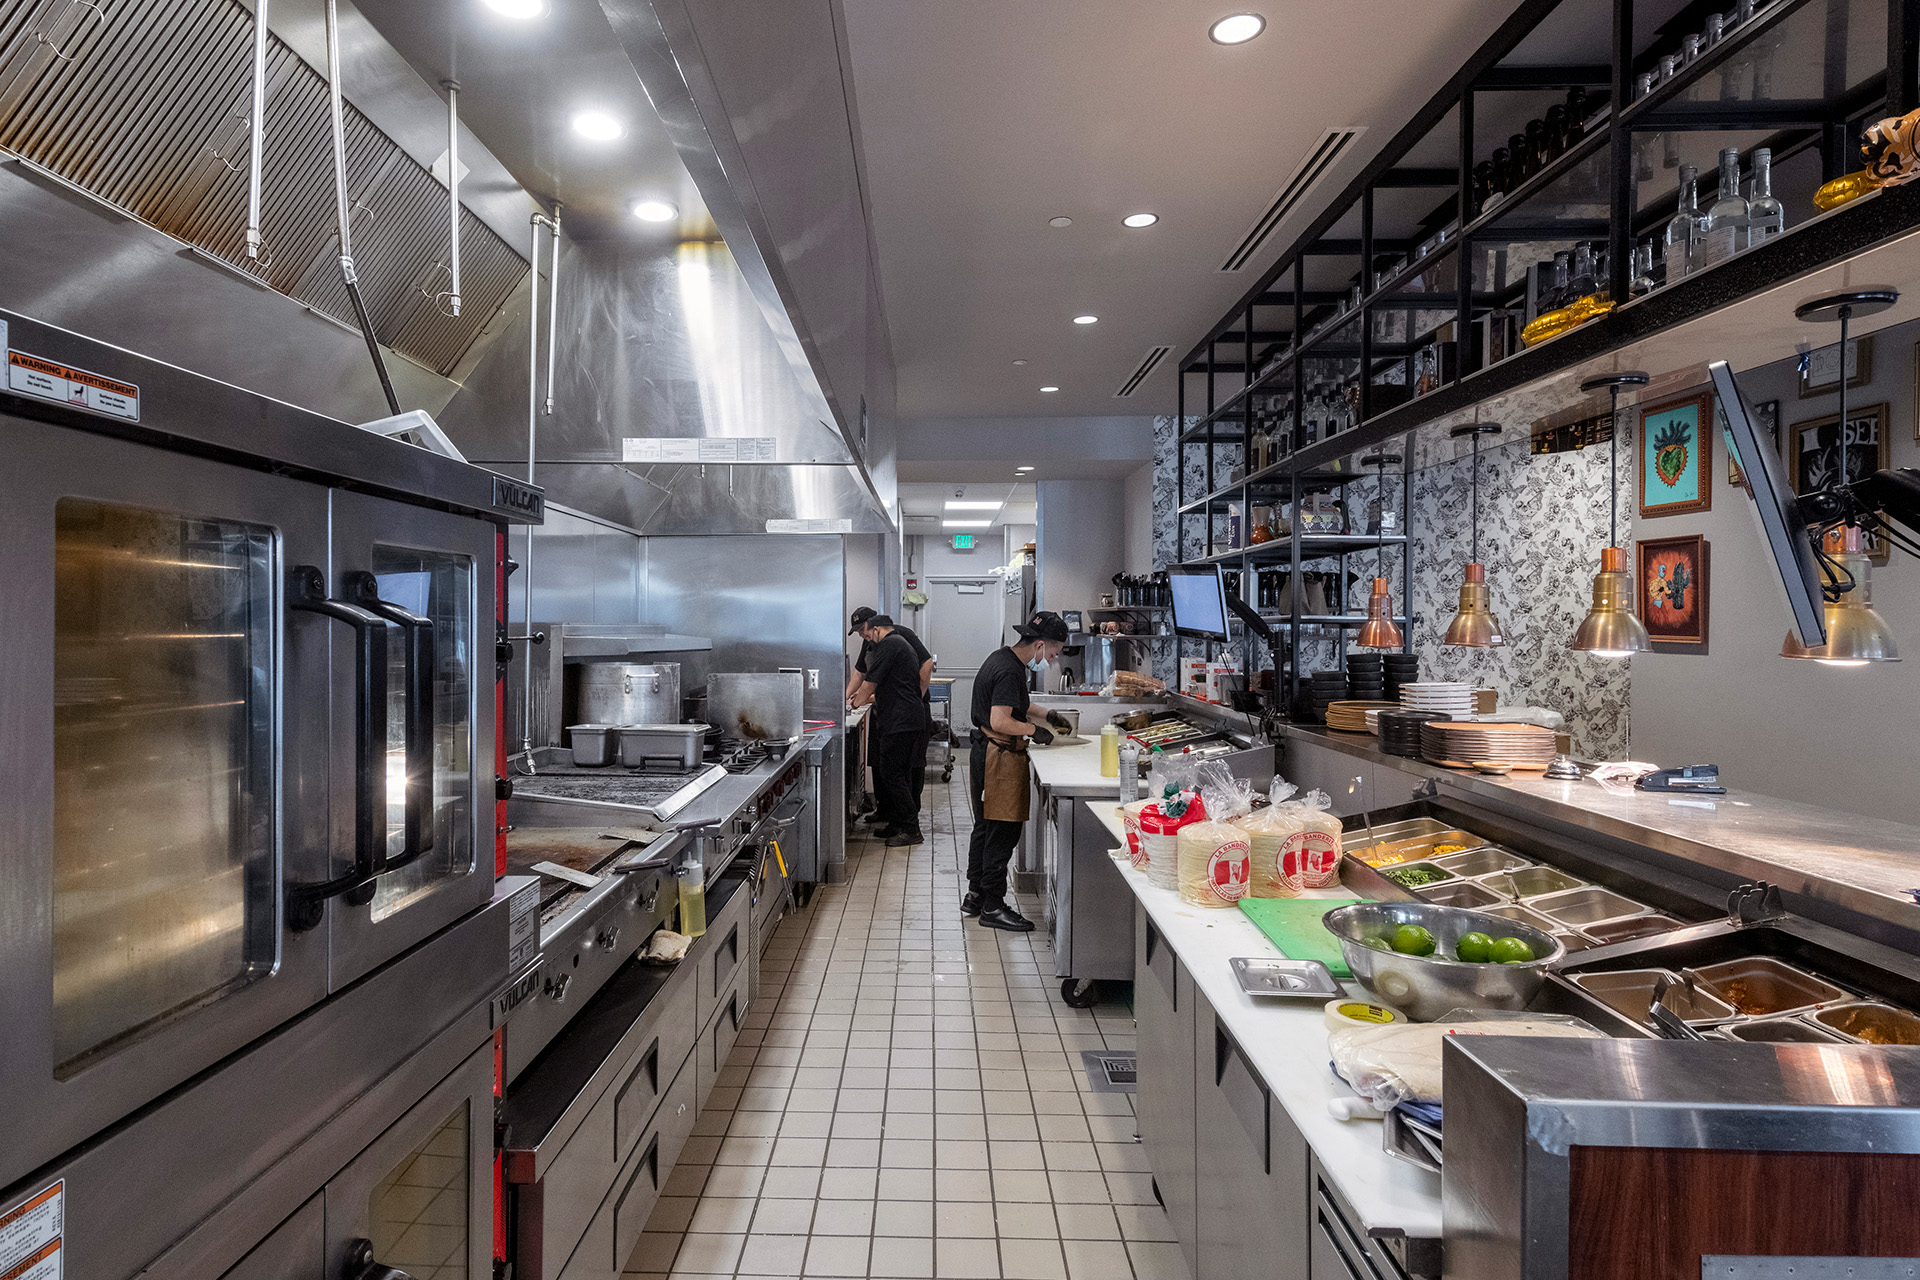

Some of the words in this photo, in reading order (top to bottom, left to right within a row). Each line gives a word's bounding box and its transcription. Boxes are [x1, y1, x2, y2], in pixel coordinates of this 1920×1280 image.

[20, 357, 62, 375] WARNING
[73, 373, 136, 396] AVERTISSEMENT
[1801, 427, 1822, 453] I
[500, 483, 540, 513] VULCAN
[955, 534, 973, 548] EXIT
[1214, 850, 1222, 858] LA
[500, 970, 539, 1014] VULCAN
